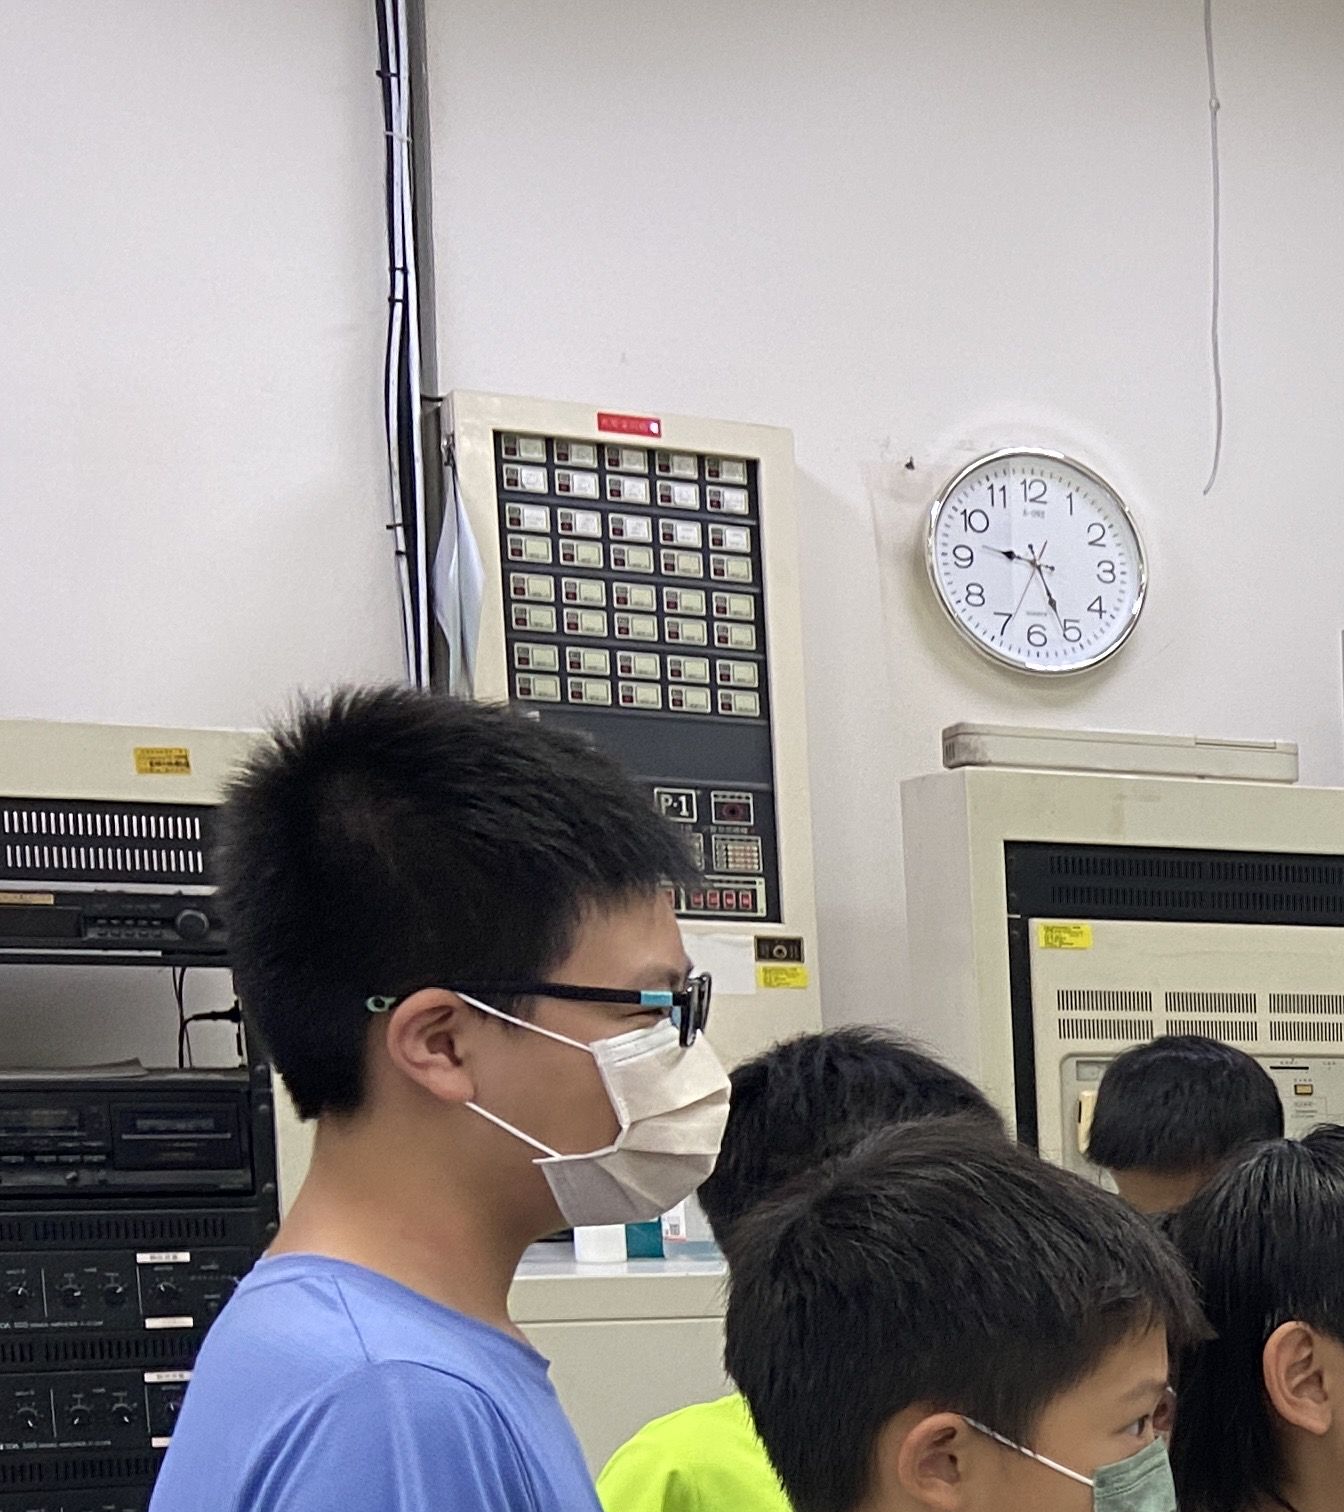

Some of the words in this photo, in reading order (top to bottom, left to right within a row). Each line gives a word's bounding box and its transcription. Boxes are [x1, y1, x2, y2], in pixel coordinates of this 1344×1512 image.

[987, 484, 1006, 508] 11
[1020, 478, 1047, 504] 12
[1066, 492, 1073, 516] 1
[960, 509, 989, 533] 10
[1087, 522, 1106, 547] 2
[952, 545, 973, 569] 9
[1097, 560, 1116, 584] 3
[965, 583, 985, 607] 8
[1087, 596, 1107, 619] 4
[993, 612, 1012, 636] 7
[1027, 624, 1047, 647] 6
[1063, 619, 1082, 642] 5
